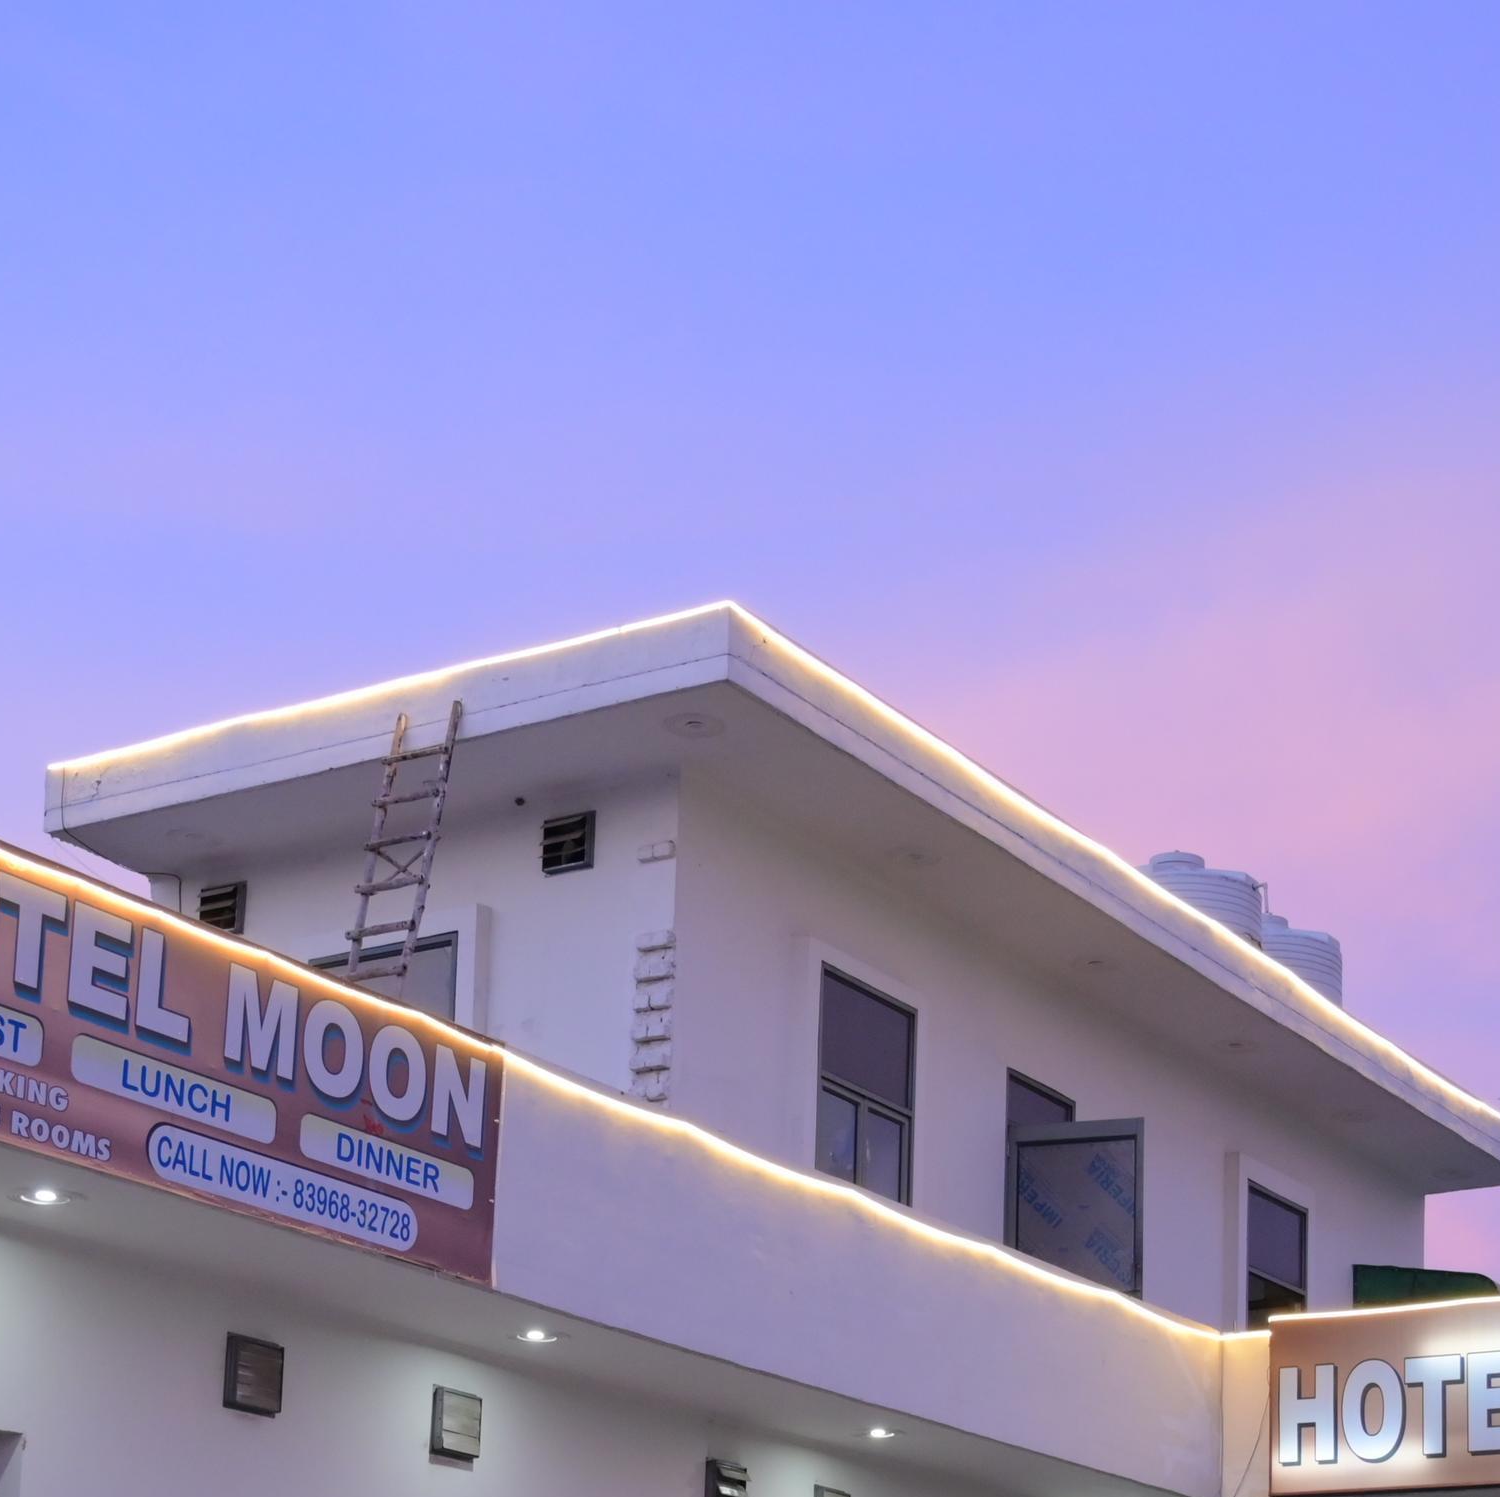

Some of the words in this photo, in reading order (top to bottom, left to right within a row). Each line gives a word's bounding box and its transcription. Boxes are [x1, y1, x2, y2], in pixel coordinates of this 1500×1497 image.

[224, 962, 487, 1150] MOON
[121, 1058, 232, 1123] LUNCH
[10, 1109, 112, 1162] ROOMS
[336, 1132, 440, 1193] DINNER
[156, 1134, 213, 1182] CALL
[220, 1153, 272, 1199] NOW
[292, 1178, 411, 1242] 83968-32728
